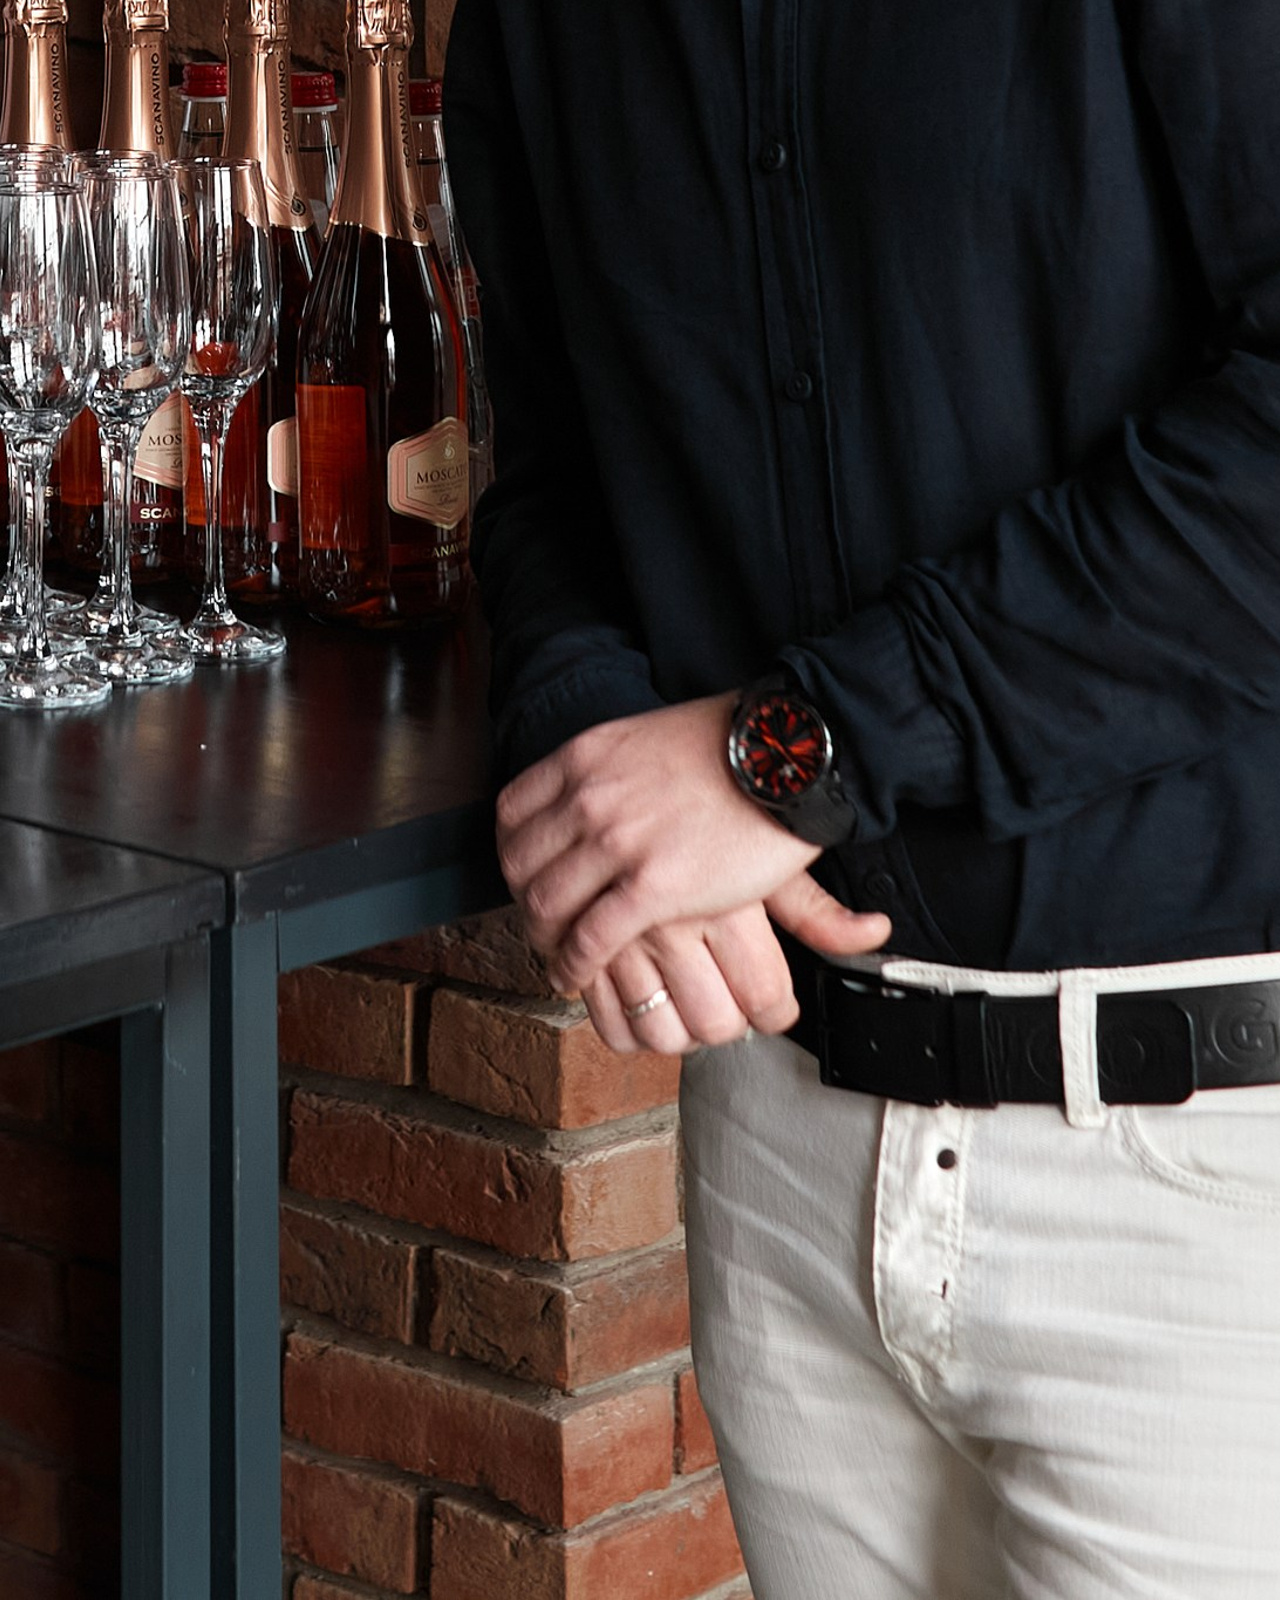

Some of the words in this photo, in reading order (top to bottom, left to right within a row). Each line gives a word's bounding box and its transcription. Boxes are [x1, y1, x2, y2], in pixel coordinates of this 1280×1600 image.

[50, 43, 63, 133] SCANAVINO
[150, 52, 165, 145] SCANAVINO
[277, 60, 293, 154] SCANAVINO
[397, 71, 411, 168] SCANAVINO
